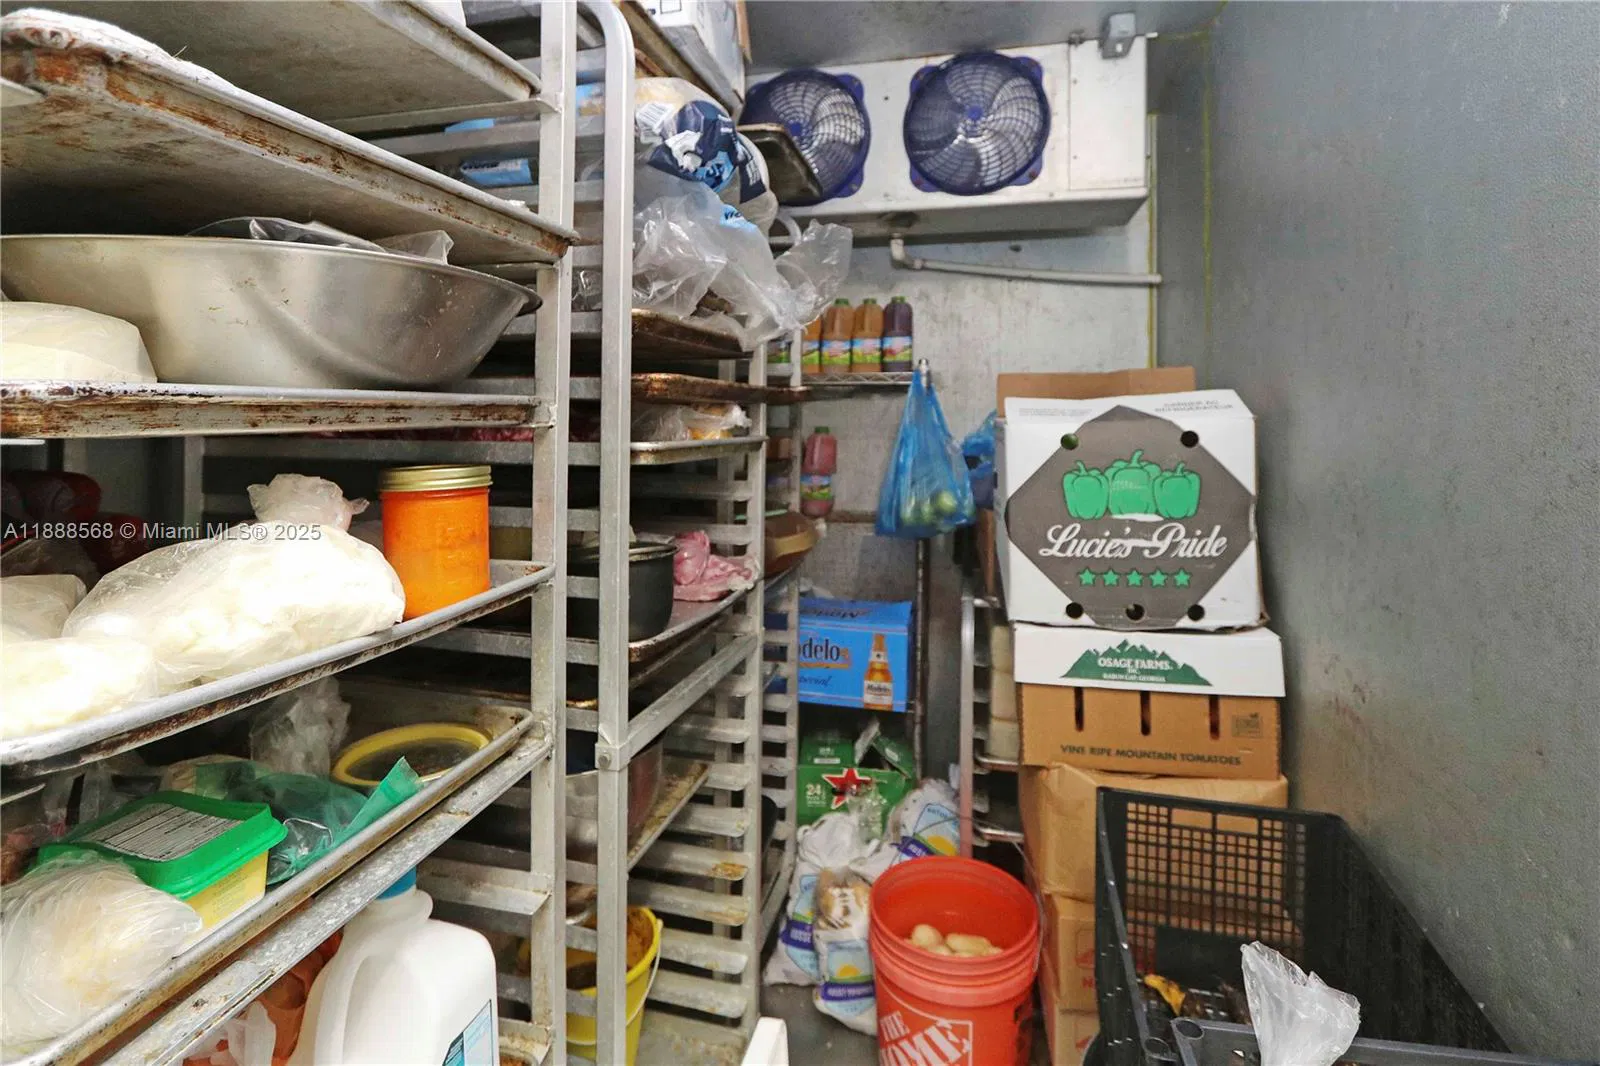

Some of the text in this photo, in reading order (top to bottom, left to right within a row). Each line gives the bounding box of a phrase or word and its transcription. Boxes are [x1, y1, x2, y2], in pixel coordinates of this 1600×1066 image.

[1038, 522, 1228, 558] Lucie's Pride
[798, 637, 841, 661] delo
[1060, 743, 1242, 766] VINE RIPE MOUNTAIN TOMATOES
[879, 1010, 910, 1042] THE
